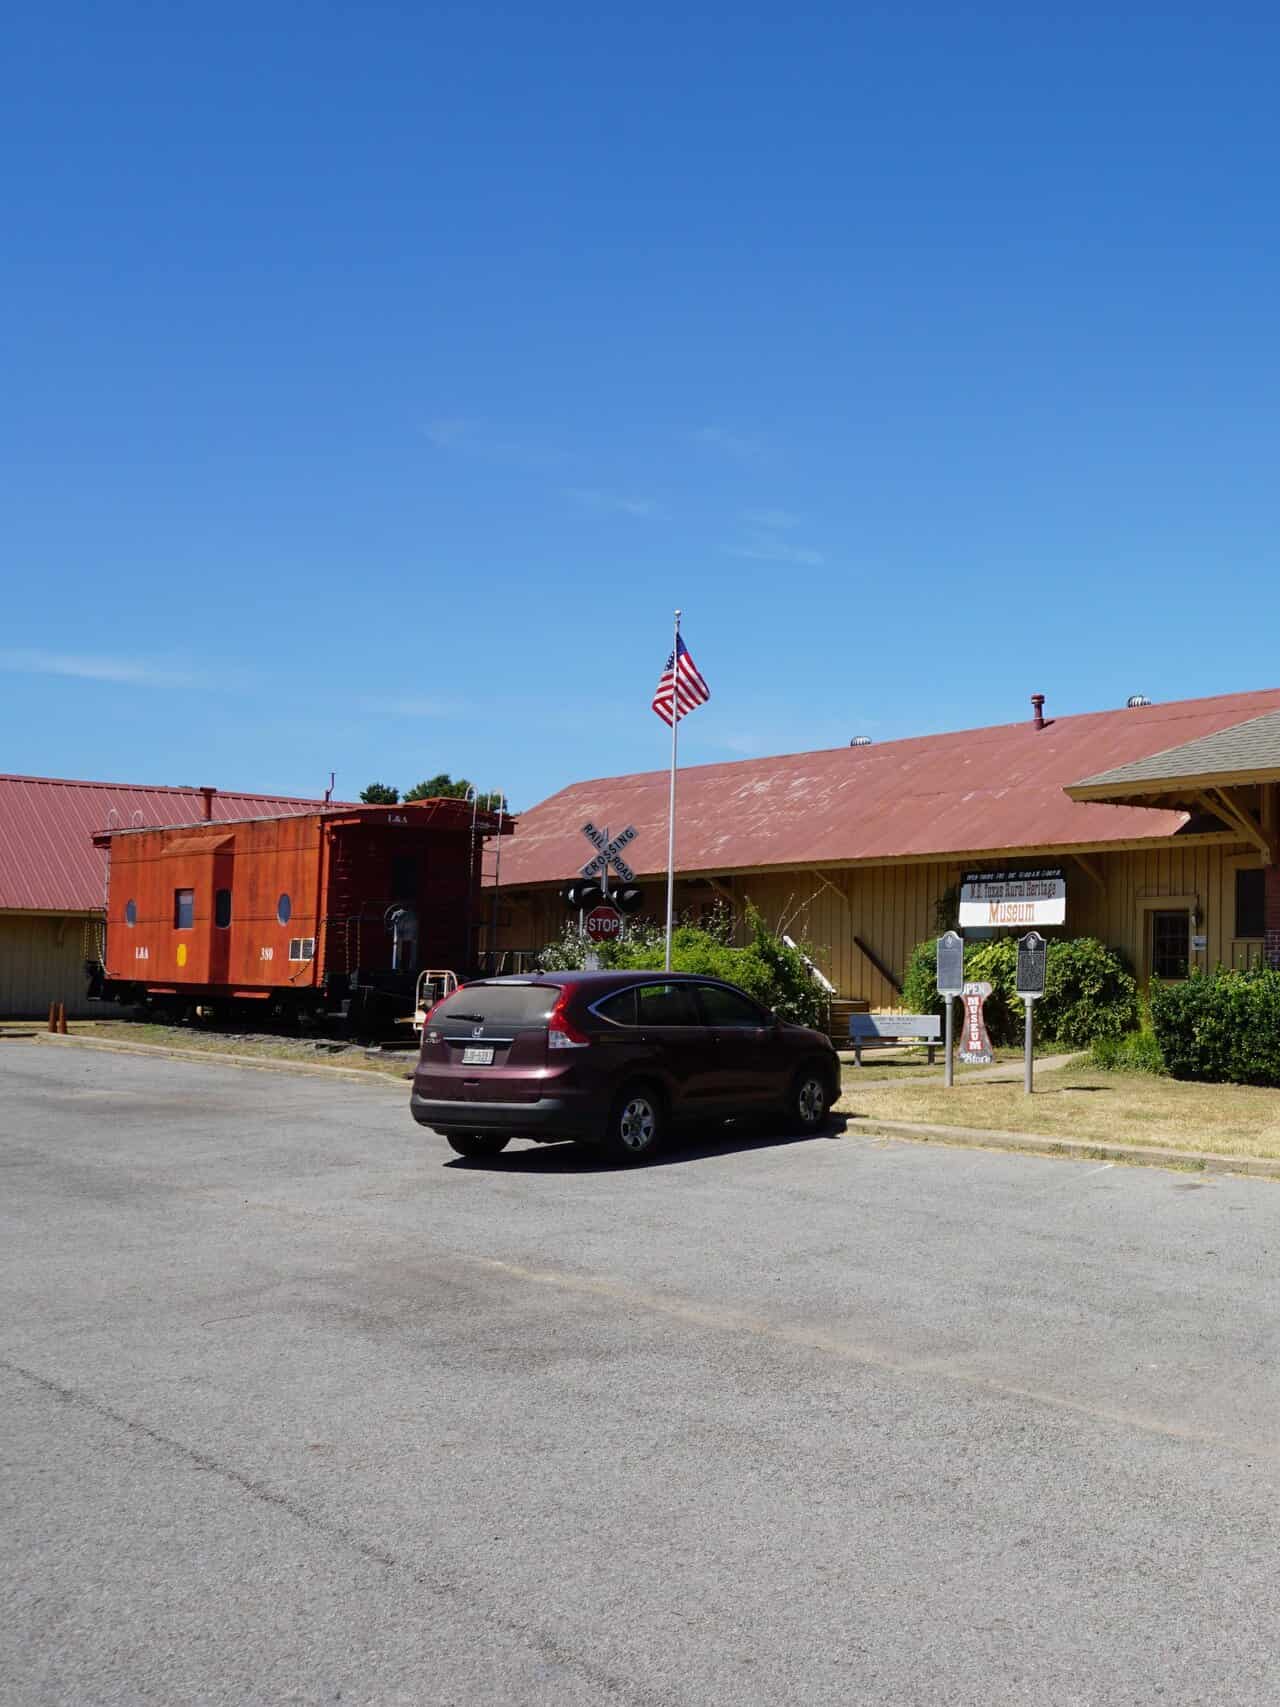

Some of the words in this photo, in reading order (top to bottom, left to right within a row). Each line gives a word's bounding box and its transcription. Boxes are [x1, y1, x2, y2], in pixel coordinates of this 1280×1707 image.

[584, 823, 604, 848] RAIL
[613, 856, 633, 881] ROAD
[584, 829, 634, 877] CROSSING
[984, 884, 1004, 898] Texas
[1005, 881, 1025, 897] Rural
[1026, 879, 1056, 899] Heritage
[989, 900, 1035, 923] Museum
[588, 918, 619, 932] STOP
